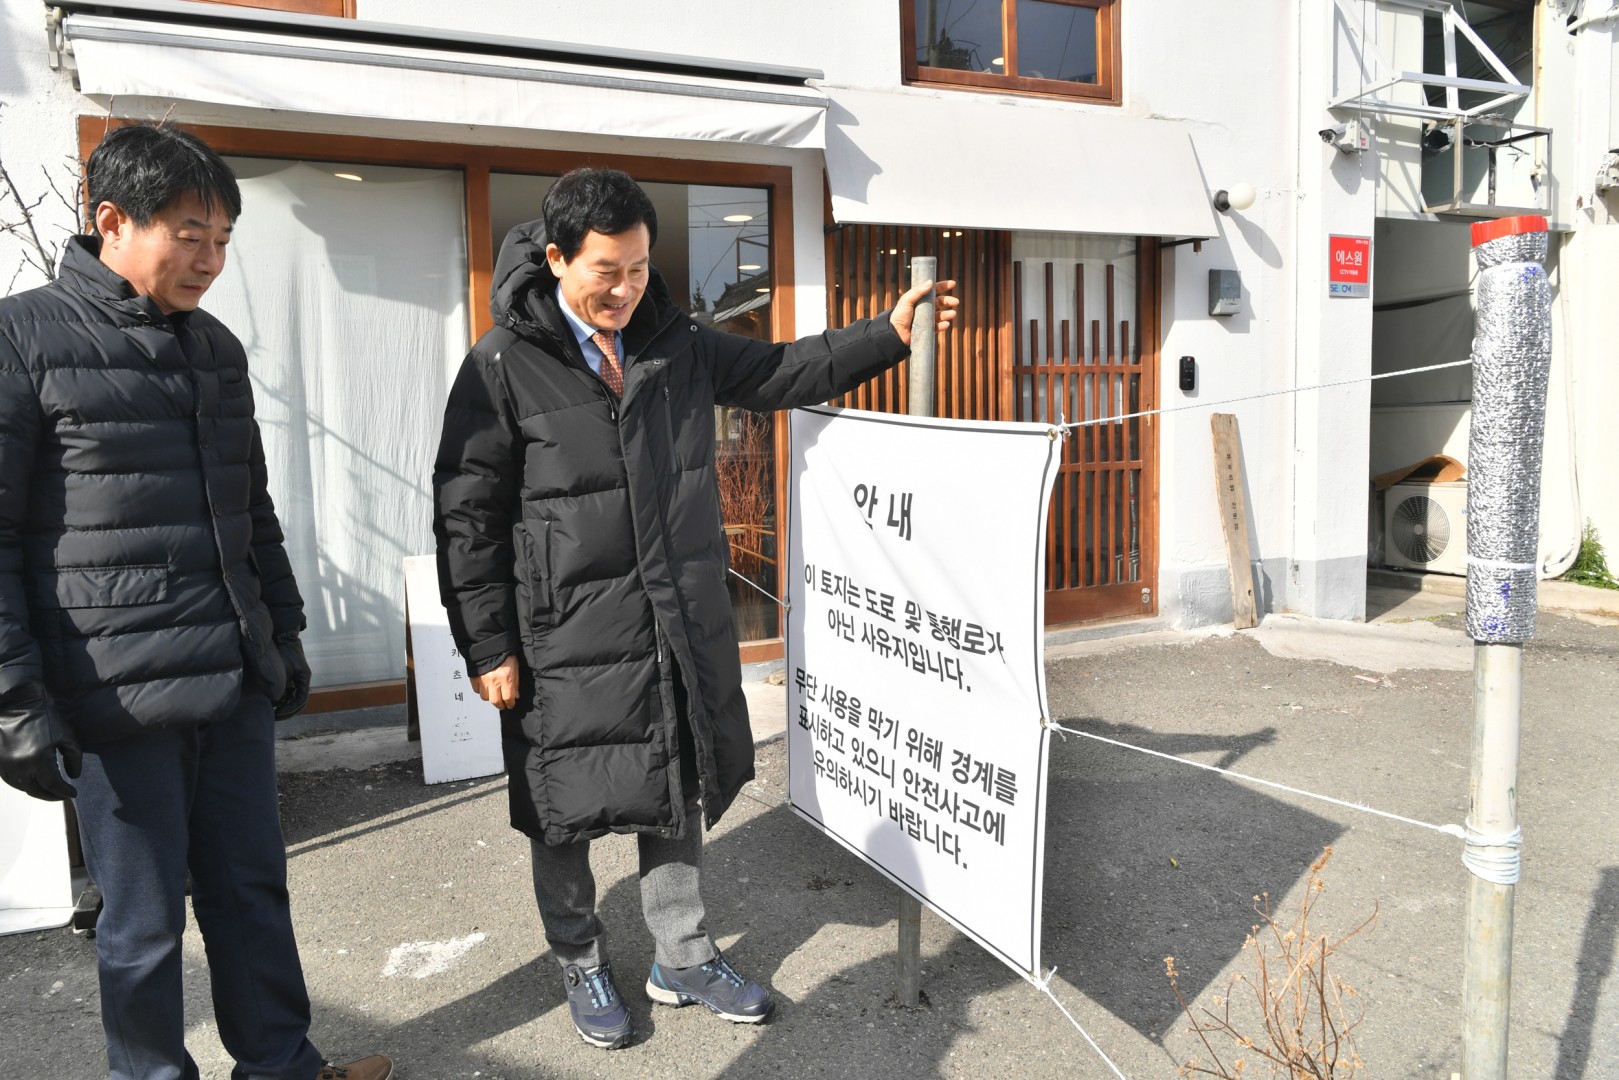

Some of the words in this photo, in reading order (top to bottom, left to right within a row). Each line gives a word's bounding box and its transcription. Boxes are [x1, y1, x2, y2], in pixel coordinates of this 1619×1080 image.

[1335, 250, 1362, 266] 에스원
[804, 564, 816, 591] 이
[820, 569, 861, 608] 토지는
[865, 587, 896, 622] 도로
[905, 600, 922, 633] 및
[828, 609, 855, 643] 아닌
[861, 622, 972, 693] 사유지입니다.
[795, 667, 818, 702] 무단
[821, 683, 862, 728] 사용을
[868, 707, 899, 750] 막기
[905, 728, 943, 772] 위해
[951, 749, 1018, 806] 경계를
[798, 704, 845, 754] 표시하고
[851, 737, 895, 788] 있으니
[903, 768, 1006, 846] 안전사고에
[813, 749, 882, 817] 유의하시기
[889, 798, 968, 870] 바랍니다.
